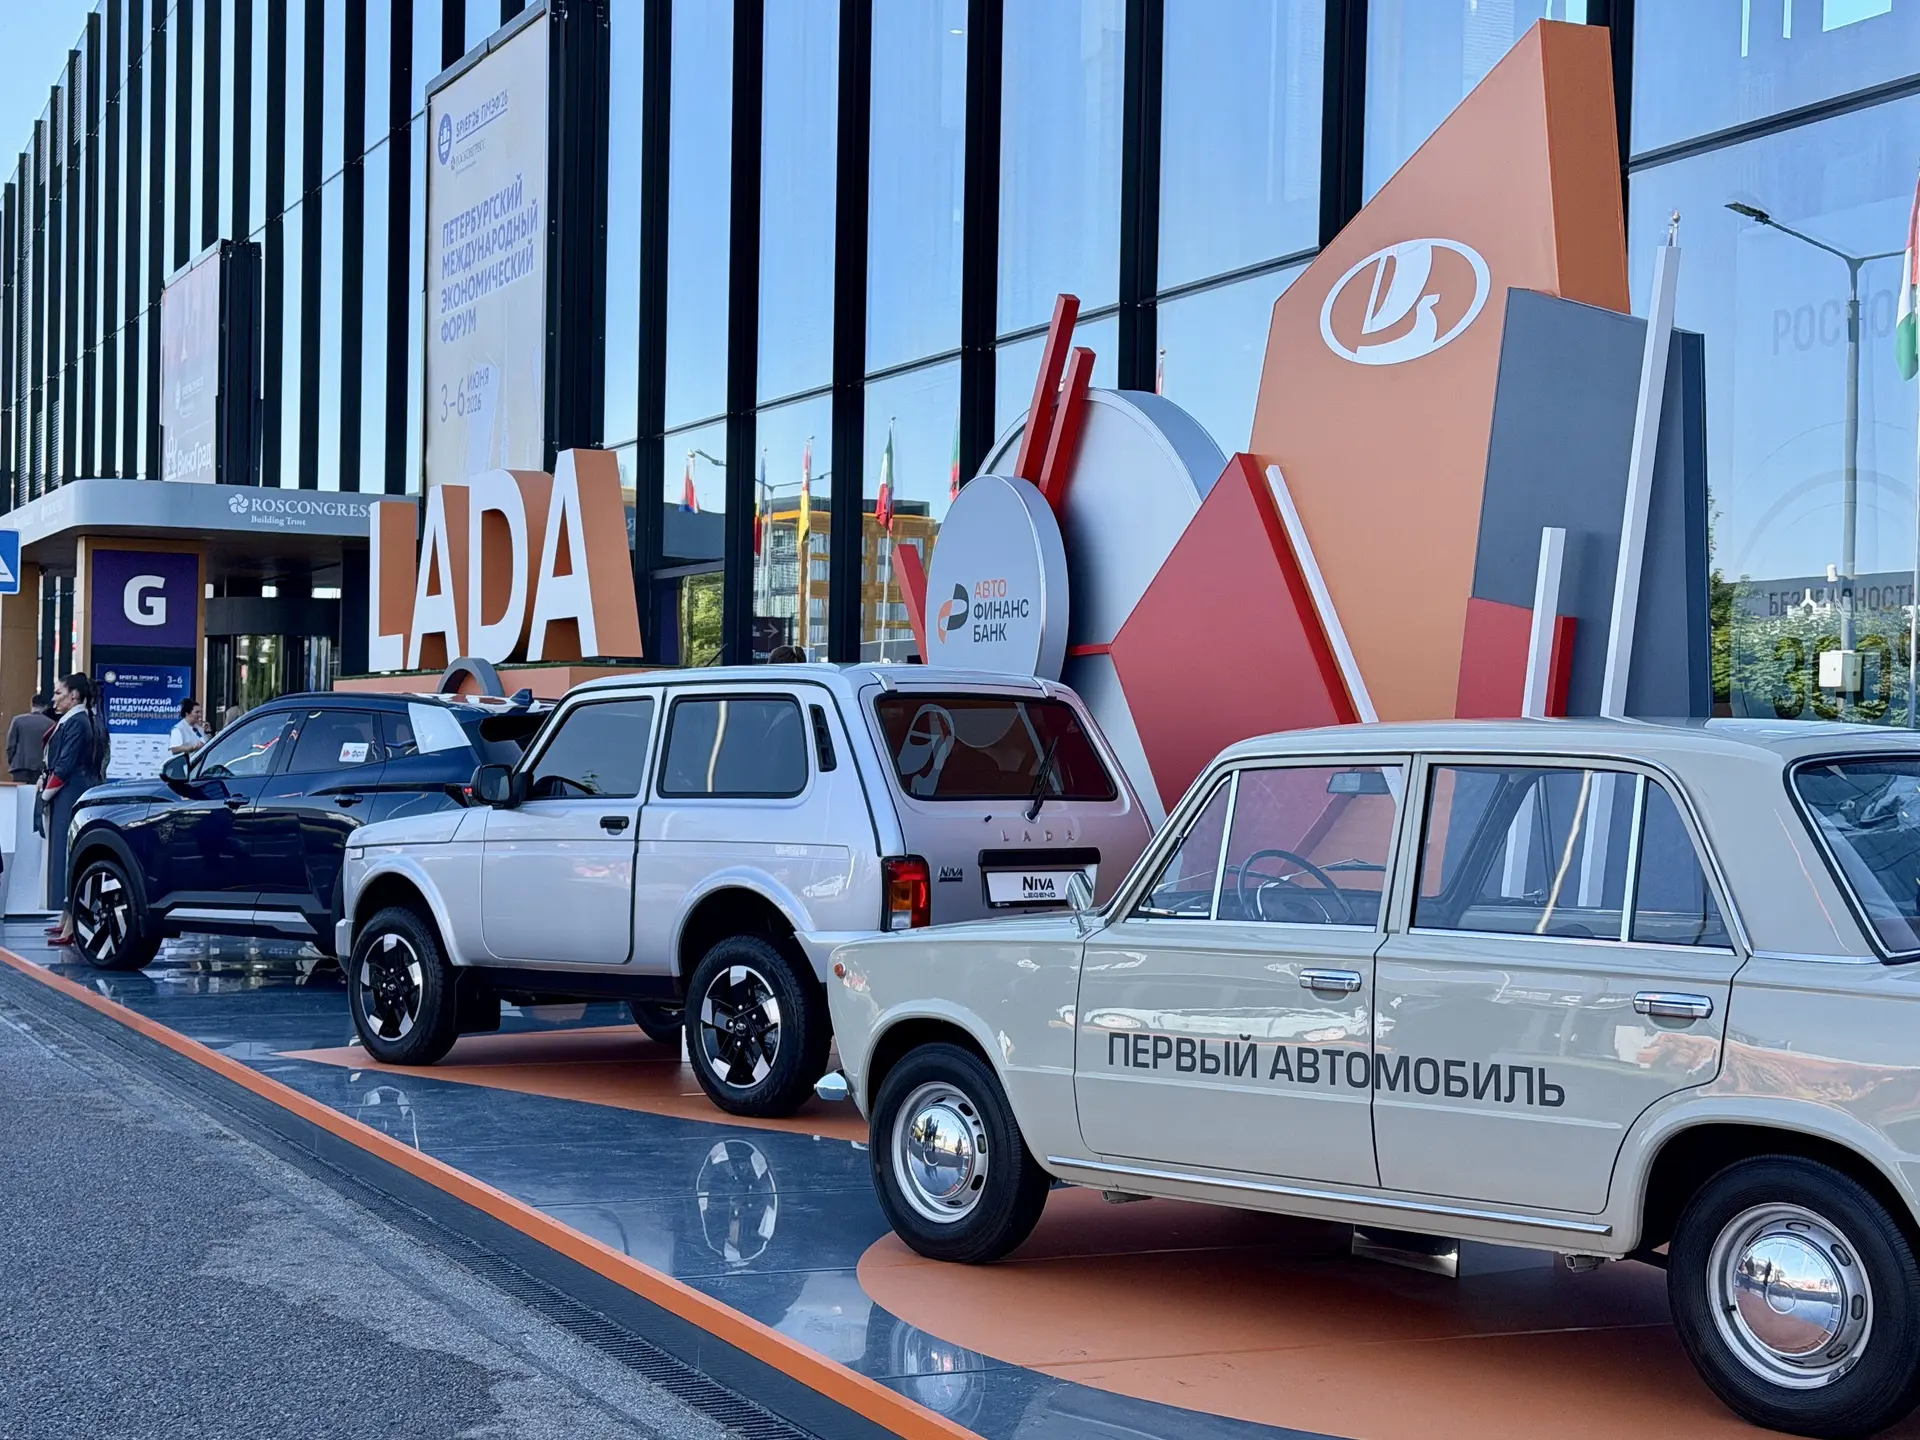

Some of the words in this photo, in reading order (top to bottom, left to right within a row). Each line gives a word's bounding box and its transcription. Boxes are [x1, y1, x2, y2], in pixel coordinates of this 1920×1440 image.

[442, 173, 522, 249] ПЕТЕРБУРГСКИЙ
[442, 198, 538, 280] МЕЖДУНАРОДНЫЙ
[441, 238, 534, 314] ЭКОНОМИЧЕСКИЙ
[441, 306, 477, 344] ФОРУМ
[467, 367, 489, 390] ИЮНЯ
[467, 393, 482, 414] 2026
[251, 498, 372, 518] ROSCONGRESS
[251, 515, 285, 527] Building
[286, 516, 306, 527] Trust
[369, 448, 600, 673] LADA
[974, 579, 1007, 599] АВТО
[123, 574, 166, 626] G
[973, 598, 1029, 621] ФИНАНС
[973, 623, 1008, 643] БАНК
[109, 697, 172, 705] ПЕТЕРБУРГСКИЙ
[109, 704, 181, 713] МЕЖДУНАРОДНЫЙ
[1001, 829, 1076, 843] LADA
[1022, 876, 1055, 891] NIVA
[1023, 891, 1056, 899] LEGEND
[1108, 1031, 1258, 1079] ПЕРВЫЙ
[1269, 1045, 1567, 1108] АВТОМОБИЛЬ
